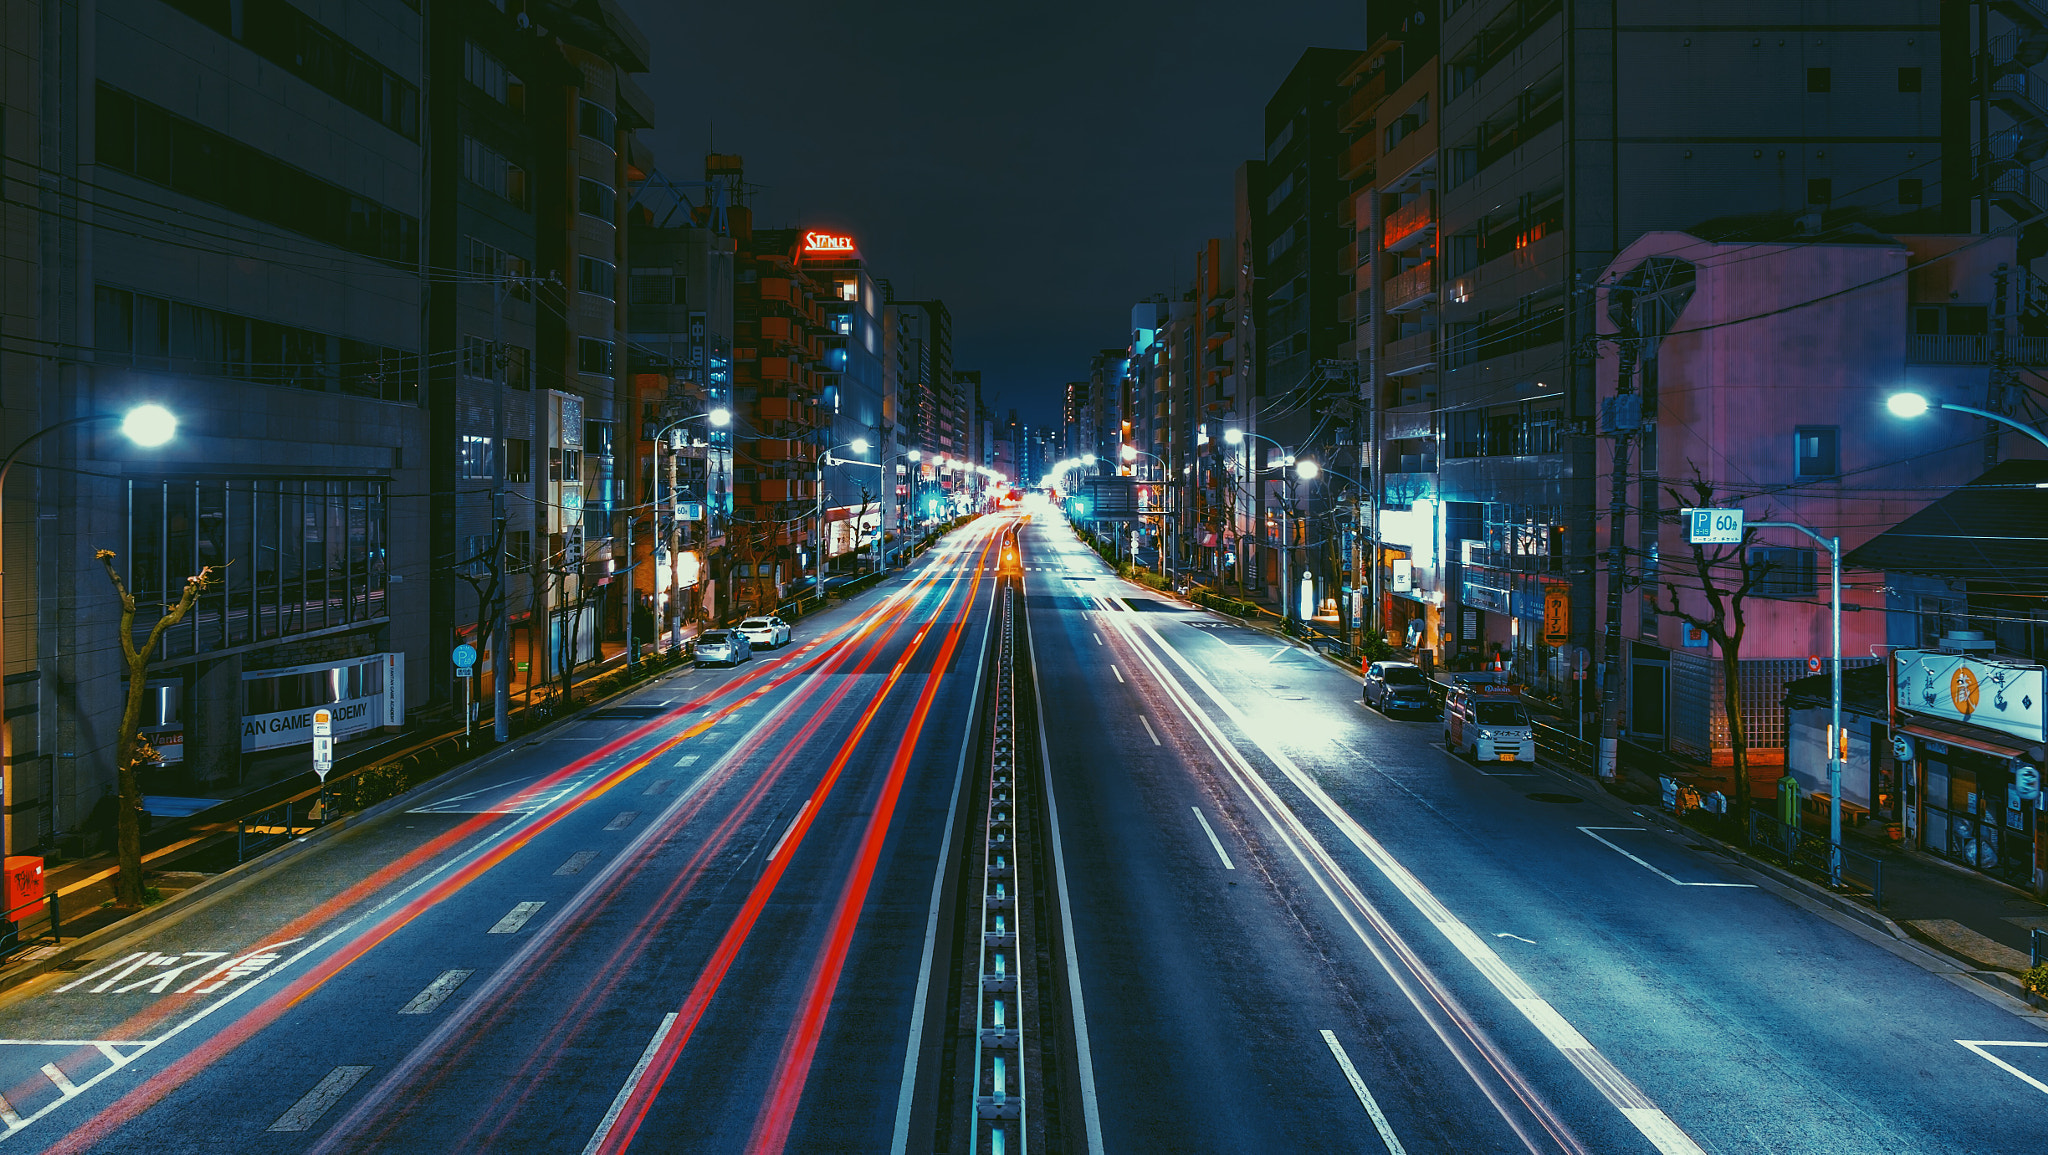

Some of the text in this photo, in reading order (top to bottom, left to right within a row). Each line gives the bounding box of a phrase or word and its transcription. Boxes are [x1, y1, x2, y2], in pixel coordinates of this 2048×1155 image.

[1698, 514, 1708, 527] P
[1716, 515, 1738, 531] 60分
[1550, 599, 1562, 634] カーテン
[270, 714, 311, 733] GAME
